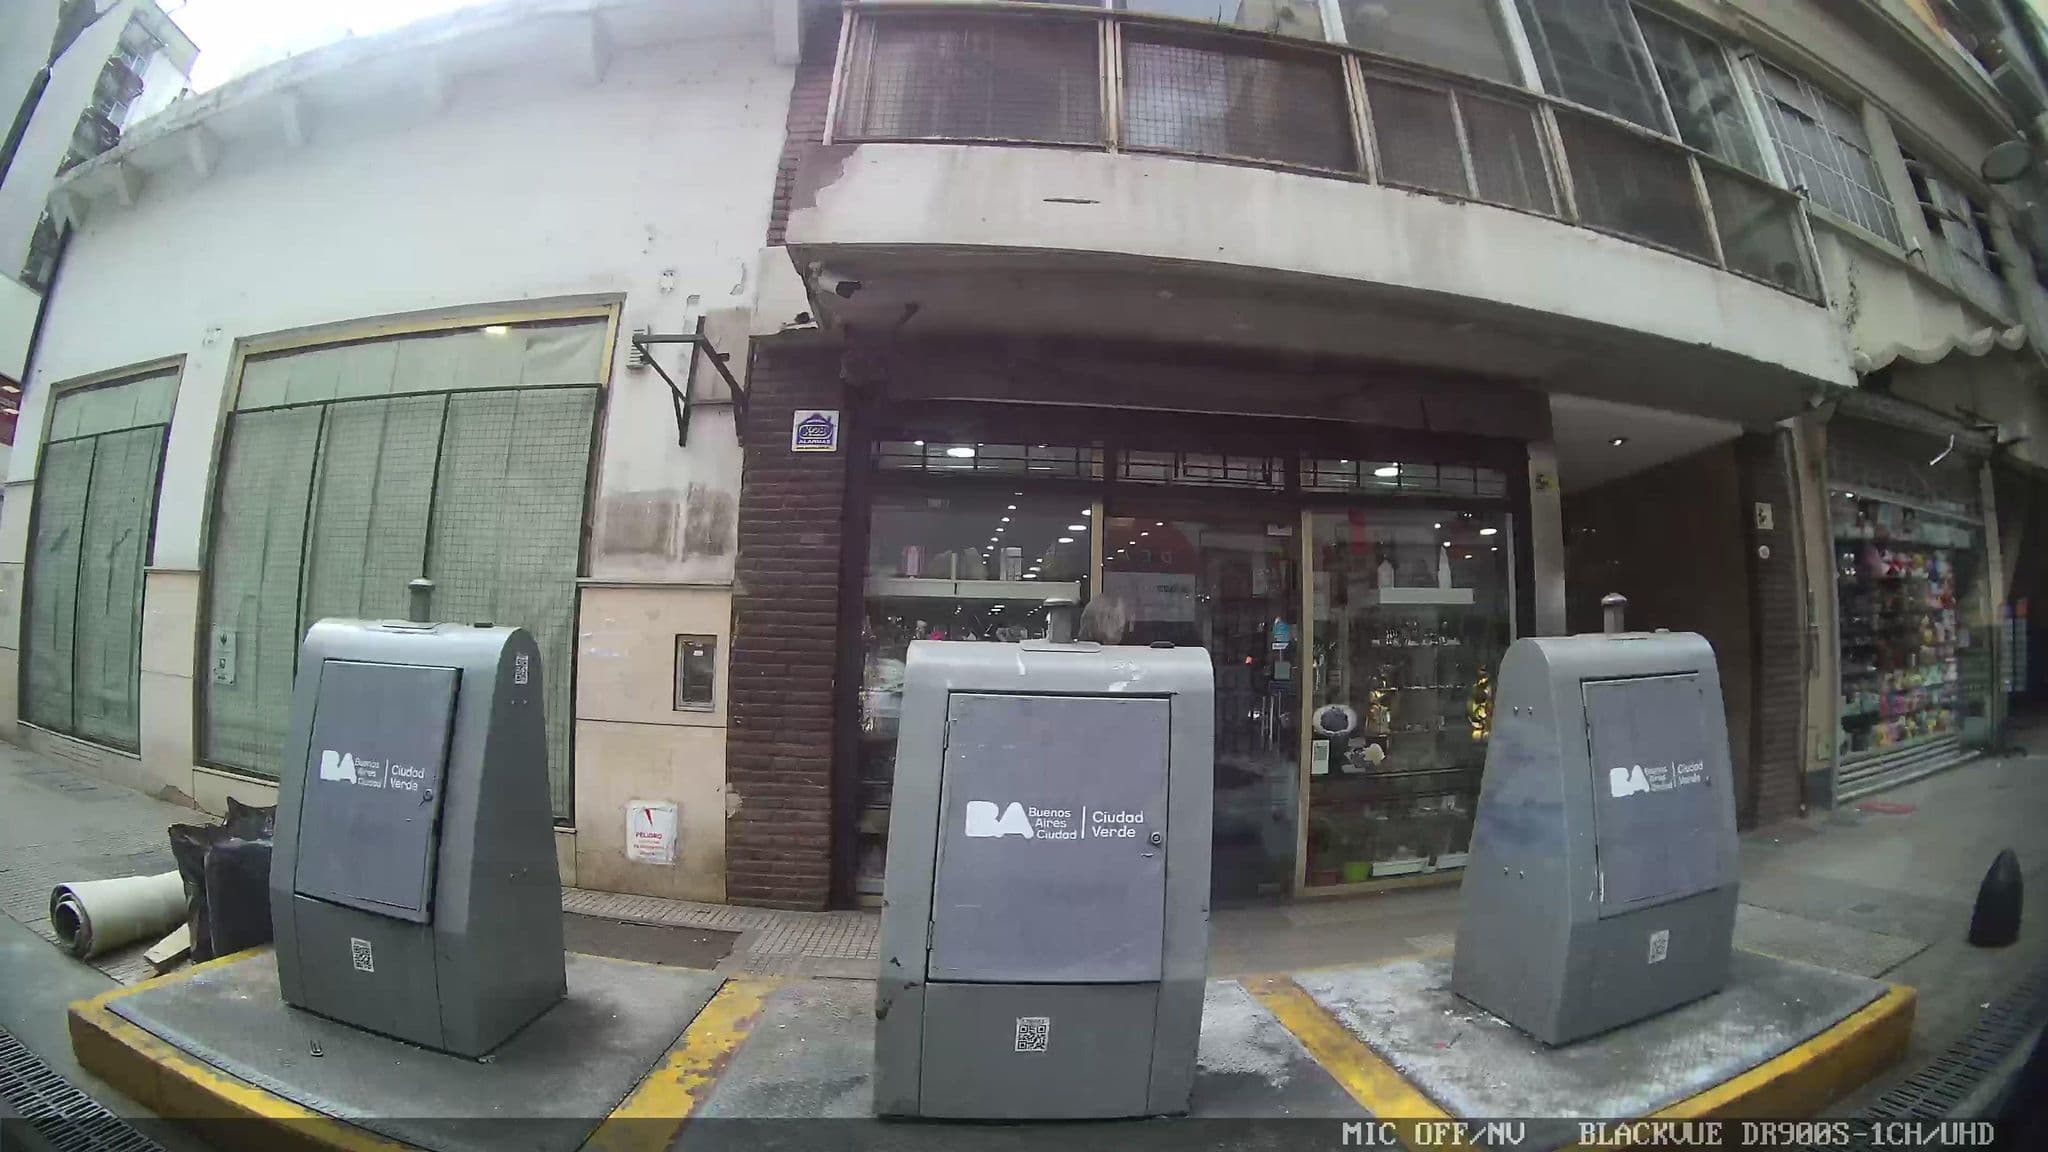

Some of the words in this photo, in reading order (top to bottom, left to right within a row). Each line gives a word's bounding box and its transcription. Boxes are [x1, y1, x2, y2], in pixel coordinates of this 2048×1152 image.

[320, 750, 357, 784] BA
[391, 765, 425, 779] Ciudad
[390, 778, 418, 791] Verde
[1610, 765, 1650, 797] BA
[1028, 807, 1071, 818] Buenos
[1092, 810, 1144, 824] Ciudad
[965, 801, 1034, 839] BA
[1035, 818, 1067, 828] Aires
[1036, 829, 1077, 840] Ciudad
[1092, 826, 1136, 838] Verde
